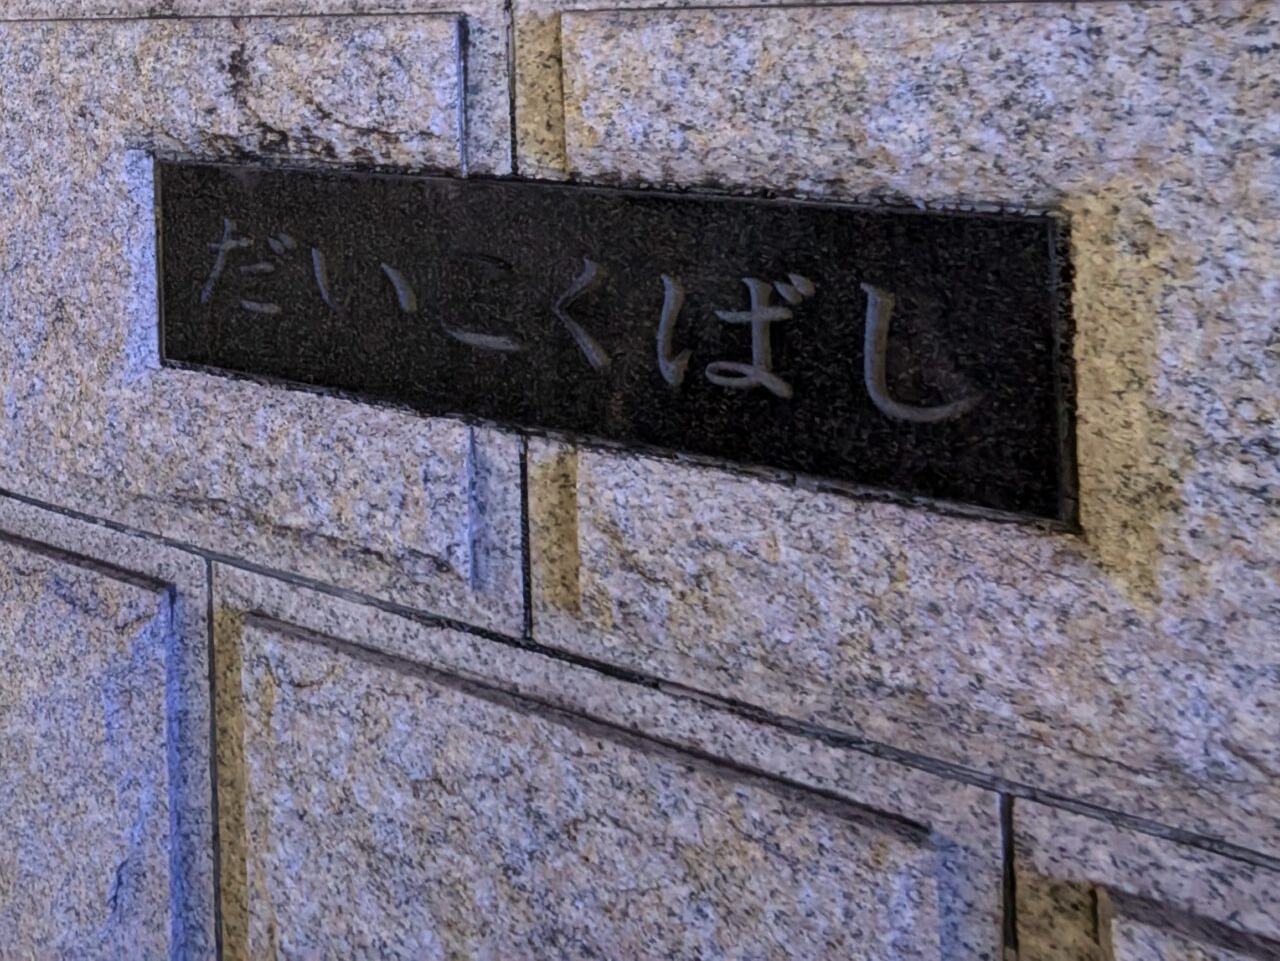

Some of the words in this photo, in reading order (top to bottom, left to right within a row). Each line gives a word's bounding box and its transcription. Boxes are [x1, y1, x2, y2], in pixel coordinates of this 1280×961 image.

[201, 216, 986, 422] だいこくばし
